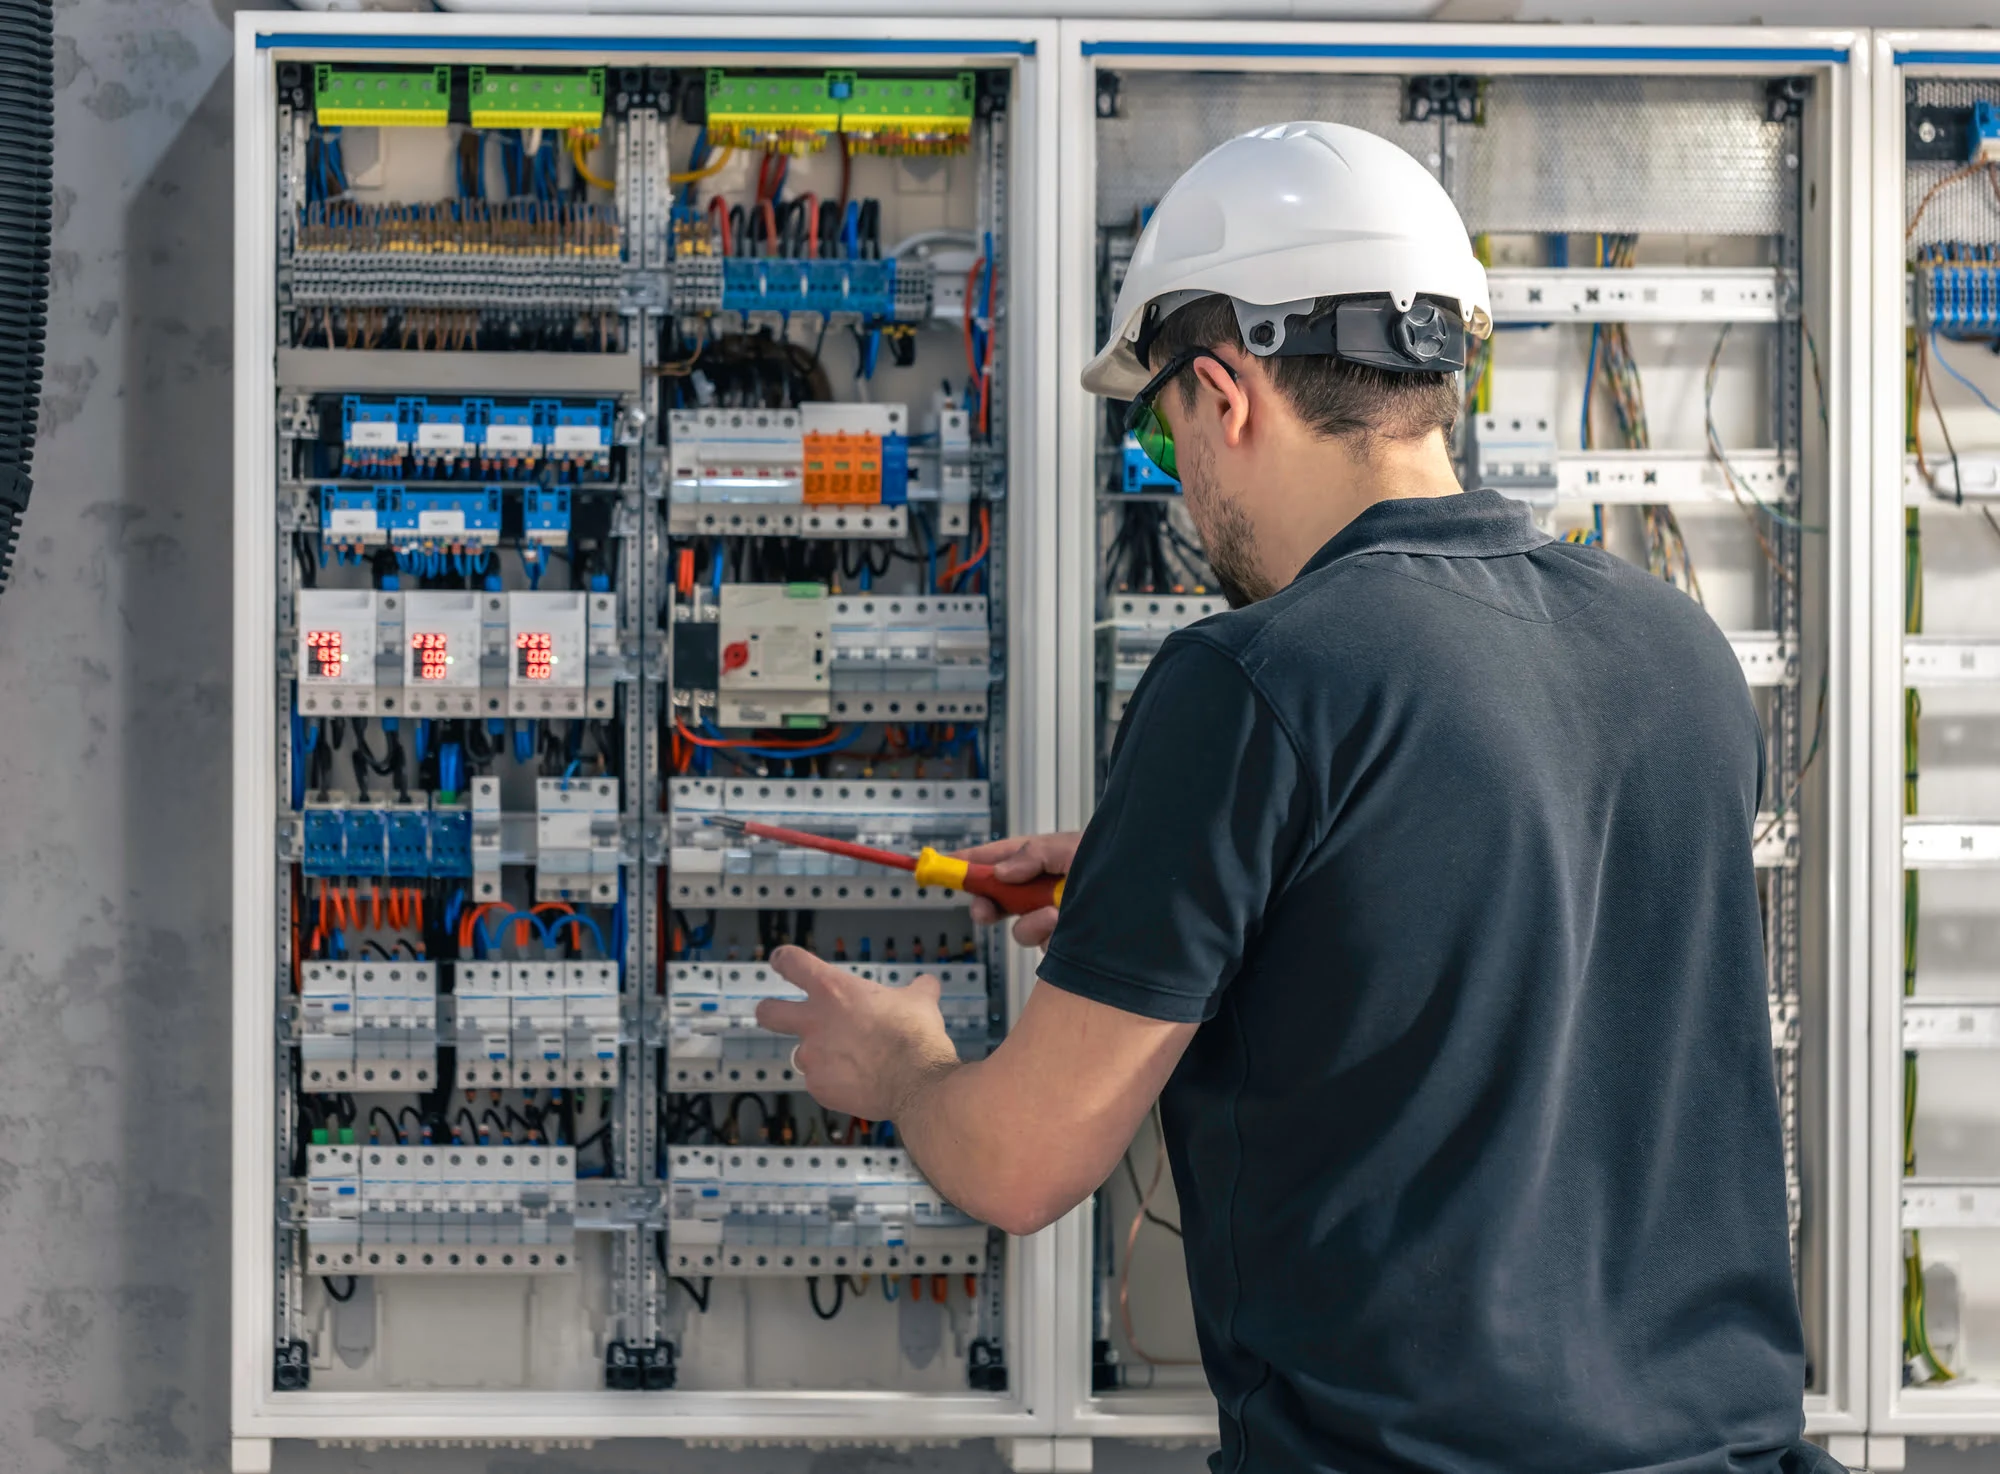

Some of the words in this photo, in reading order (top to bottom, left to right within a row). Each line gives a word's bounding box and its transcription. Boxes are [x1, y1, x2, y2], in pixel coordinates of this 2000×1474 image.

[307, 631, 341, 646] 225
[411, 633, 447, 648] 232
[516, 633, 551, 648] 225
